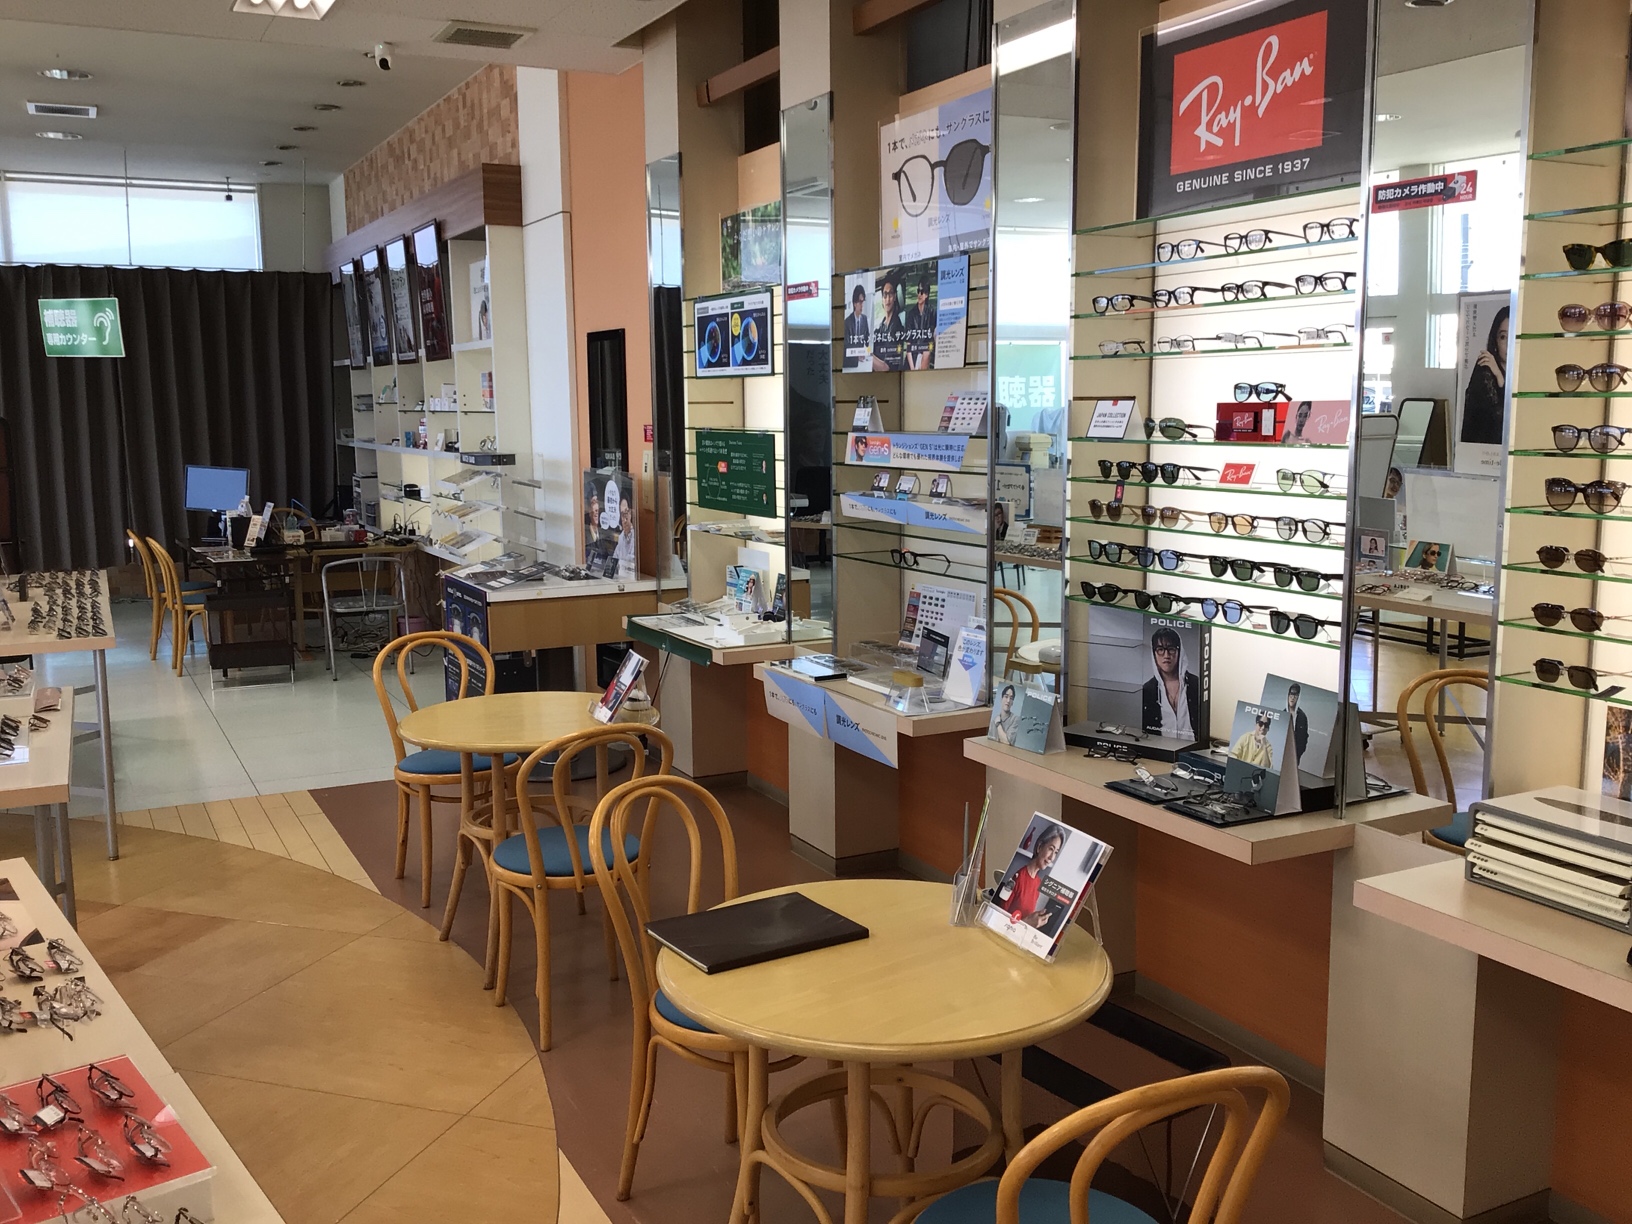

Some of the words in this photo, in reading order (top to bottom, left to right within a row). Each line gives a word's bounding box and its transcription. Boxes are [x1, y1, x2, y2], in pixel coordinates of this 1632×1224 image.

[1176, 172, 1229, 193] GENUINE
[1234, 164, 1273, 182] SINCE
[1277, 157, 1311, 175] 1937
[1378, 181, 1444, 201] 防犯カメラ作動中
[1460, 182, 1473, 194] 24
[940, 267, 965, 281] 調光レンズ
[1150, 617, 1193, 629] POLICE
[1026, 690, 1053, 702] POLICE
[1244, 705, 1281, 721] POLICE
[836, 714, 861, 732] 調光レンズ
